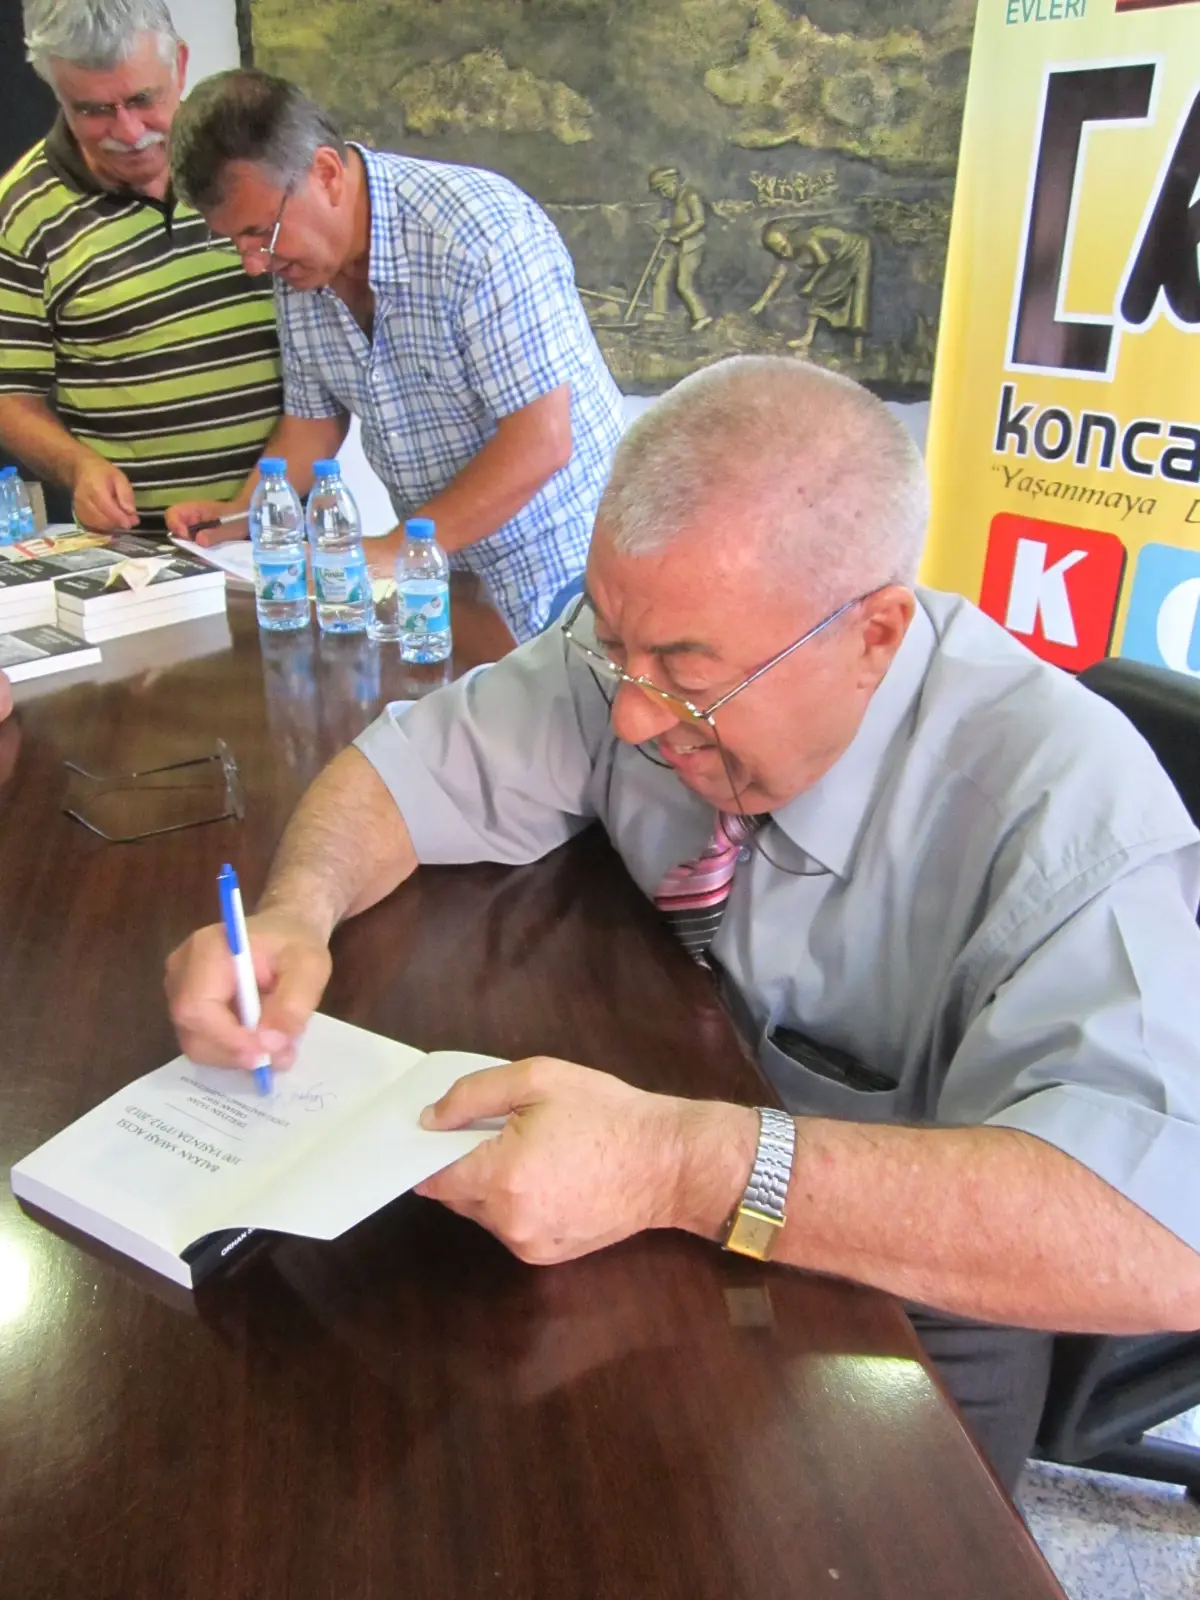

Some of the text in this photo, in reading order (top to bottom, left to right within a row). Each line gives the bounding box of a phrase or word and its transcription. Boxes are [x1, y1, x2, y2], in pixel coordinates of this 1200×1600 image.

[177, 1131, 222, 1158] YAŞINDA
[179, 1149, 220, 1173] BALKAN
[221, 1231, 247, 1256] ORHAN
